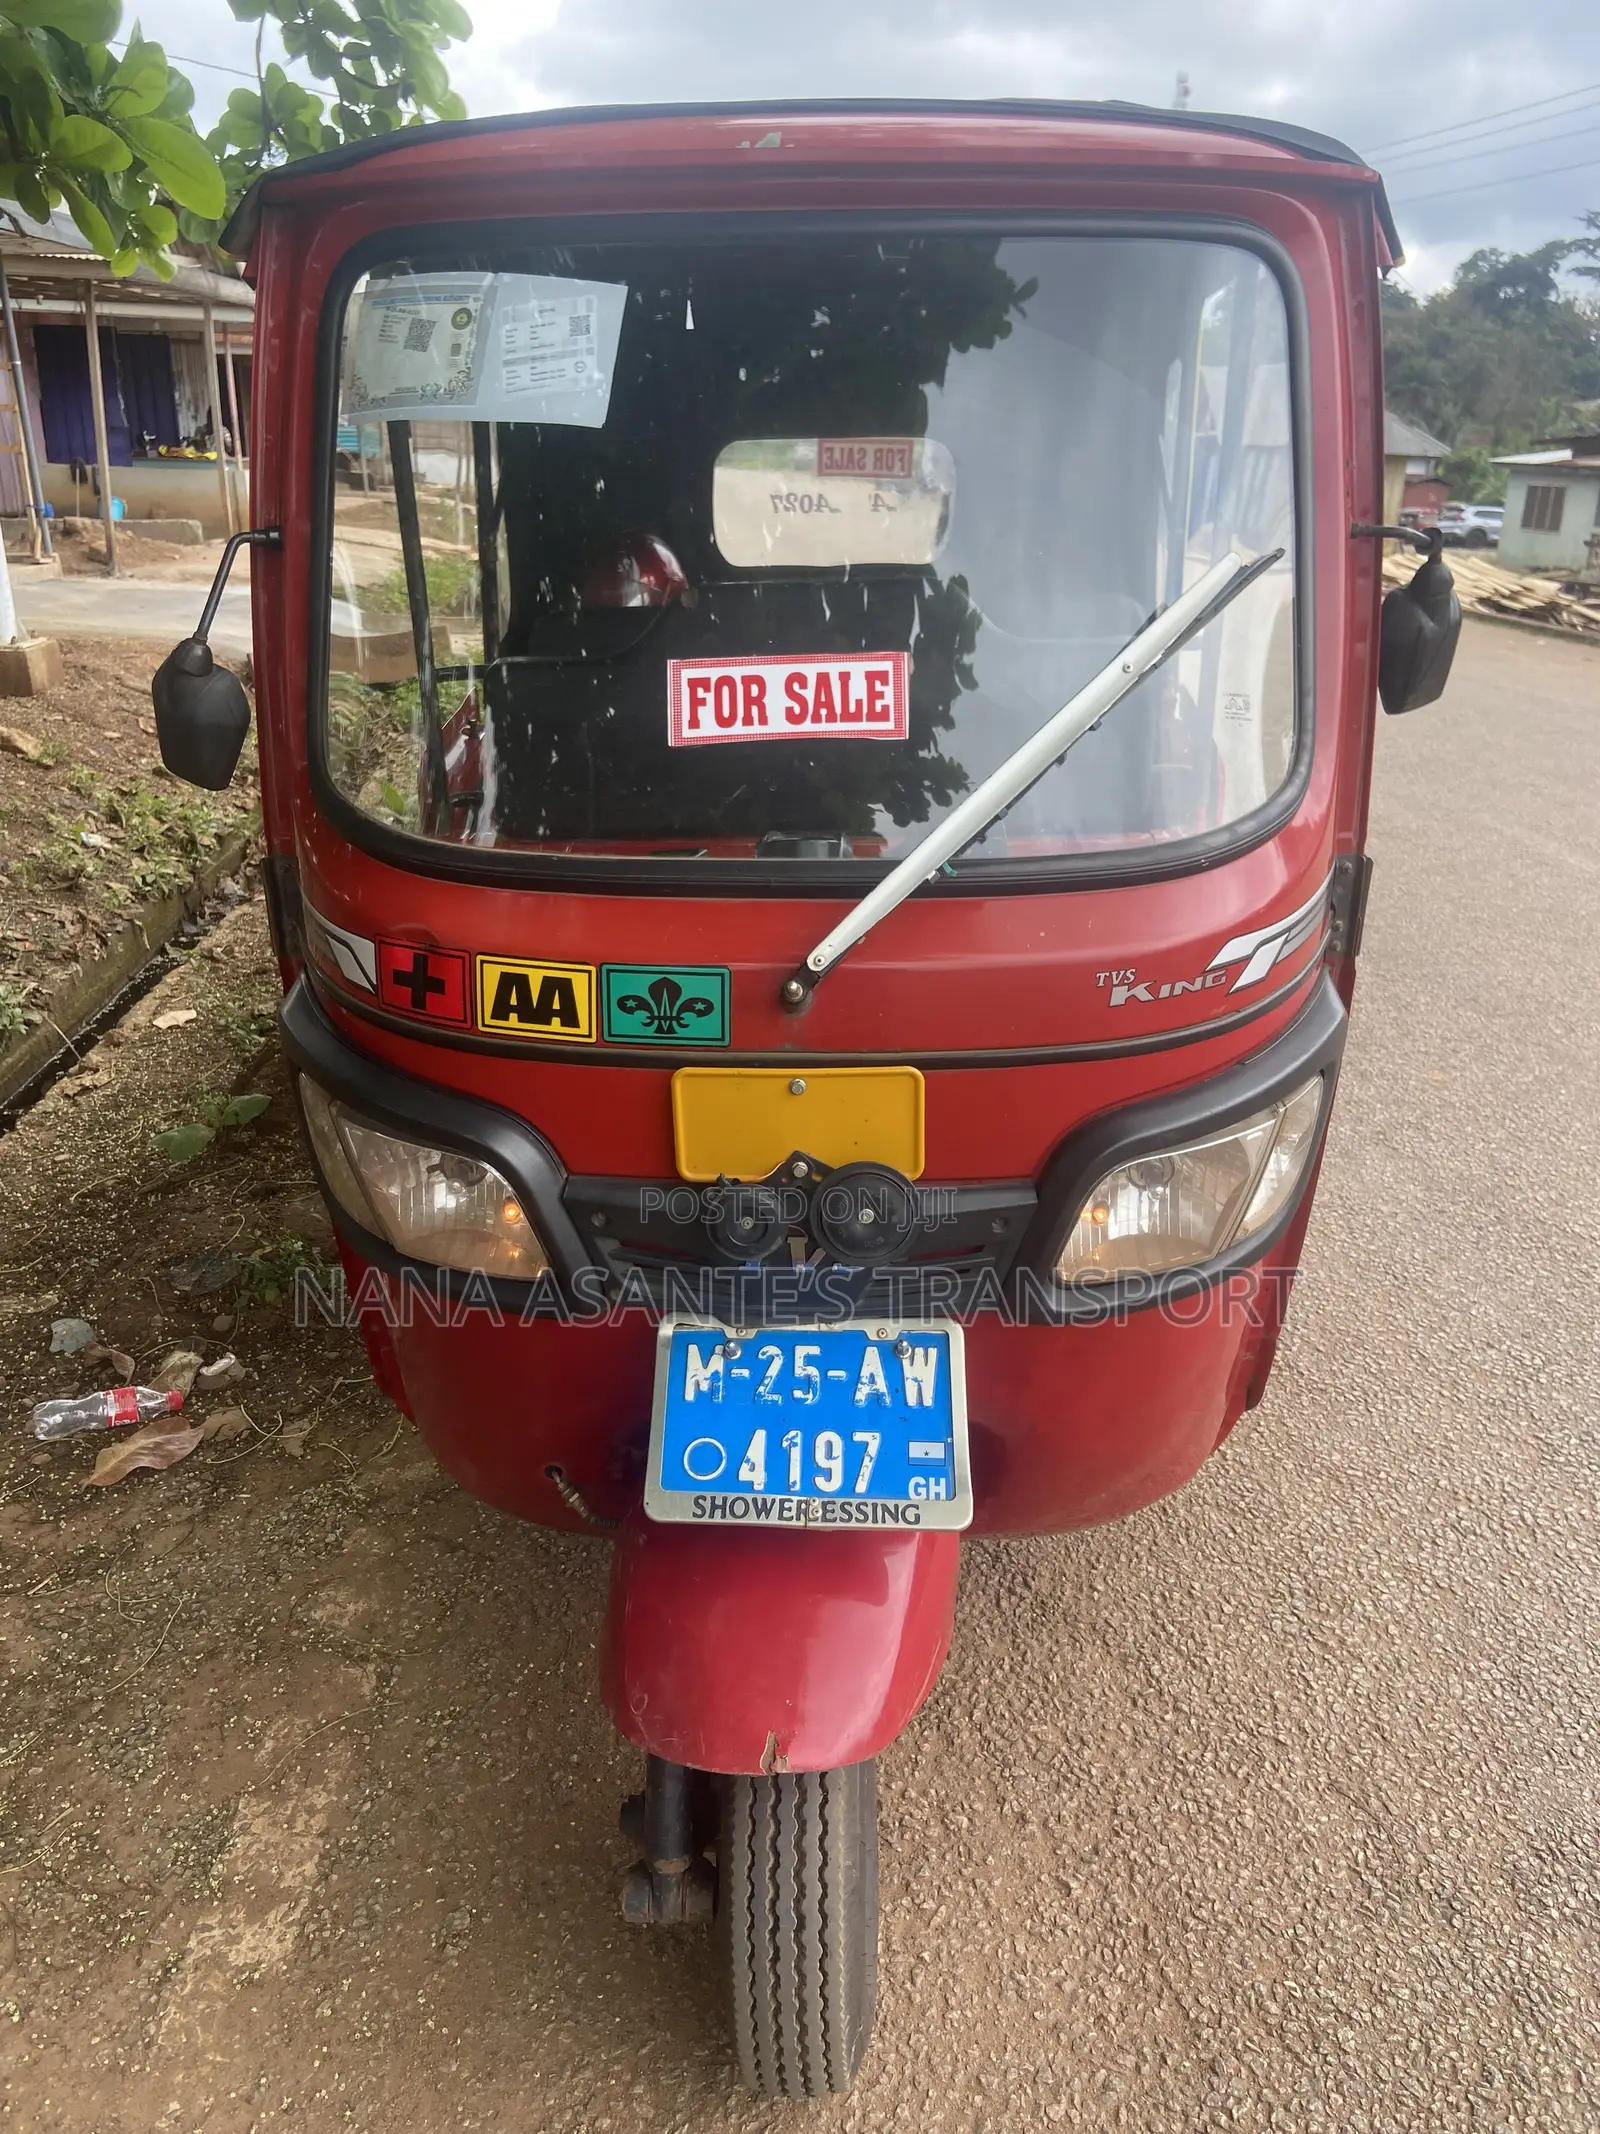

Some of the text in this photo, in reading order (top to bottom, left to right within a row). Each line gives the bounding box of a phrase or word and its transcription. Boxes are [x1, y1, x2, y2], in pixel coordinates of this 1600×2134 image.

[687, 670, 891, 730] FOR SALE
[490, 971, 581, 1029] AA
[1096, 968, 1136, 987] TVS
[1108, 970, 1228, 1007] KING
[684, 1344, 938, 1408] M-25-AW
[738, 1428, 946, 1501] 4197 GH
